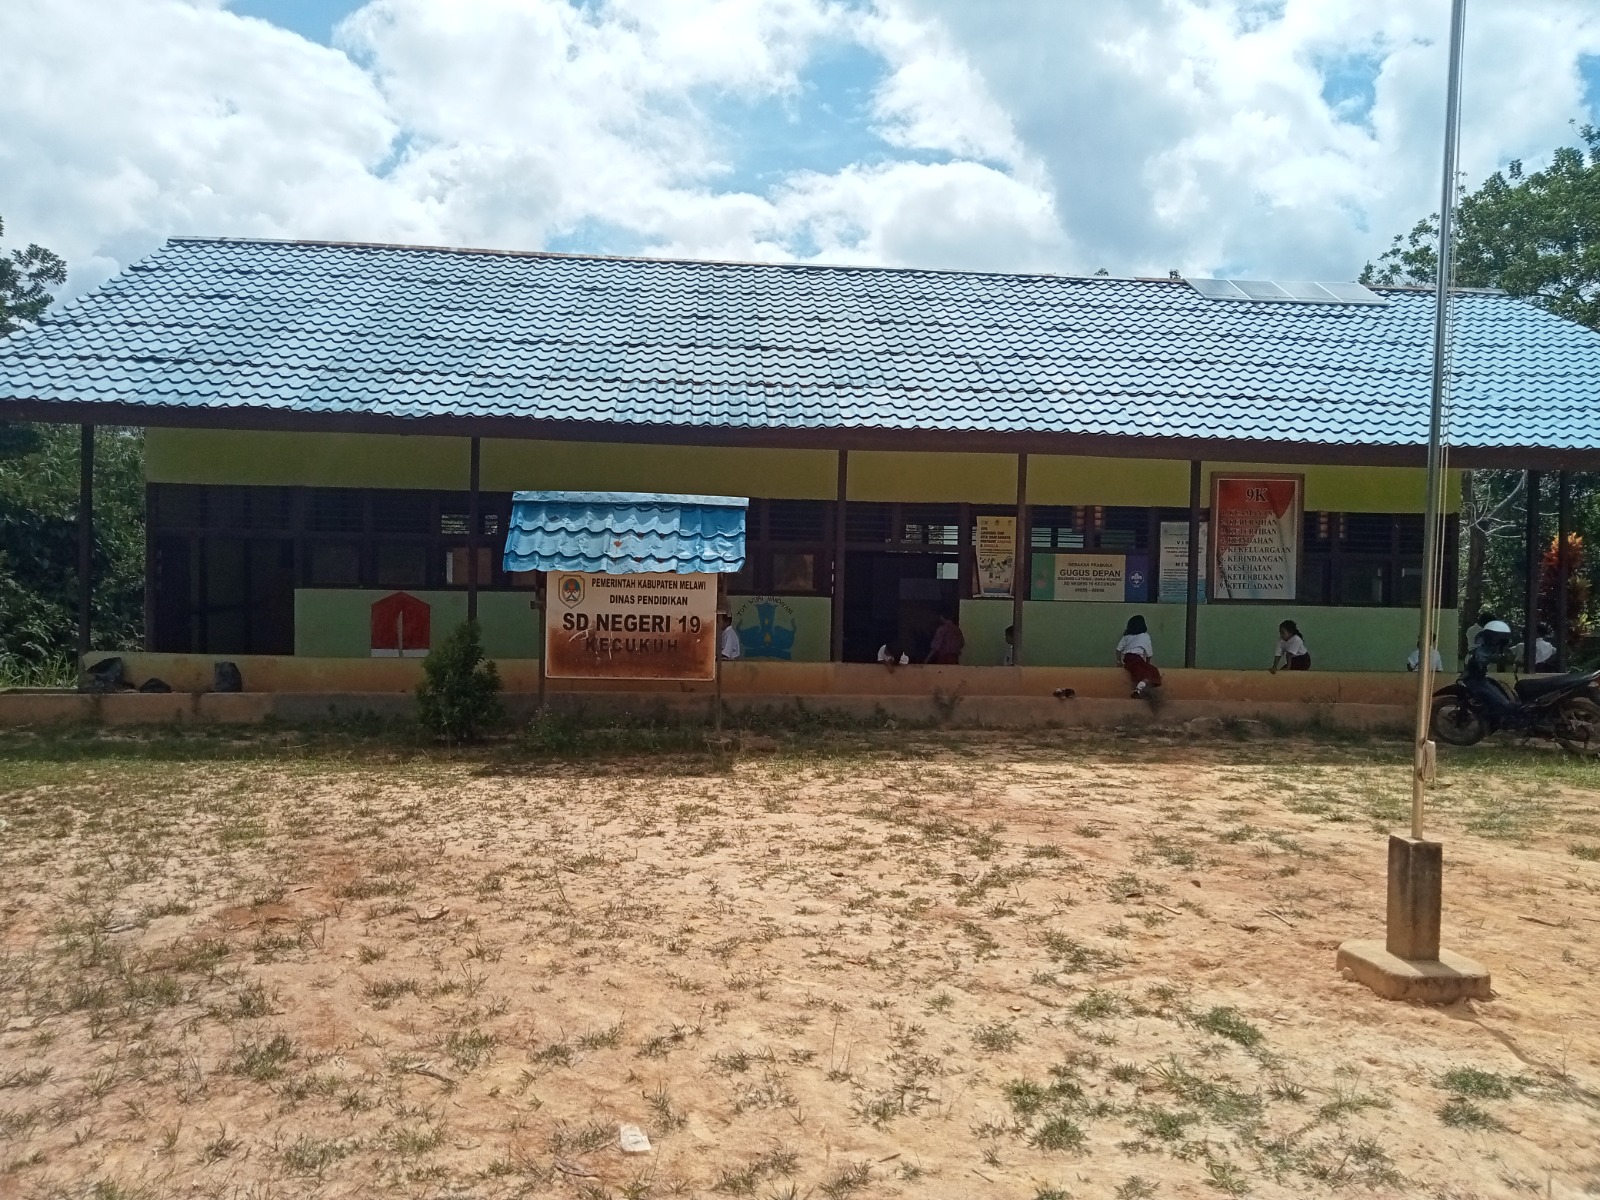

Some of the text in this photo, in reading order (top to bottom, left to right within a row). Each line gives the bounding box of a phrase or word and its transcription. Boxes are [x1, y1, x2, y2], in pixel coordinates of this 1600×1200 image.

[1246, 487, 1268, 502] 9K
[1092, 569, 1121, 577] DEPAN
[592, 578, 706, 590] PEMERINTAH KABUPATEN MELAWI
[610, 595, 688, 605] DINAS PENDIDIKAN
[737, 604, 747, 616] TUT
[563, 613, 700, 633] SD NEGERI 19
[586, 638, 678, 652] KECUKUH
